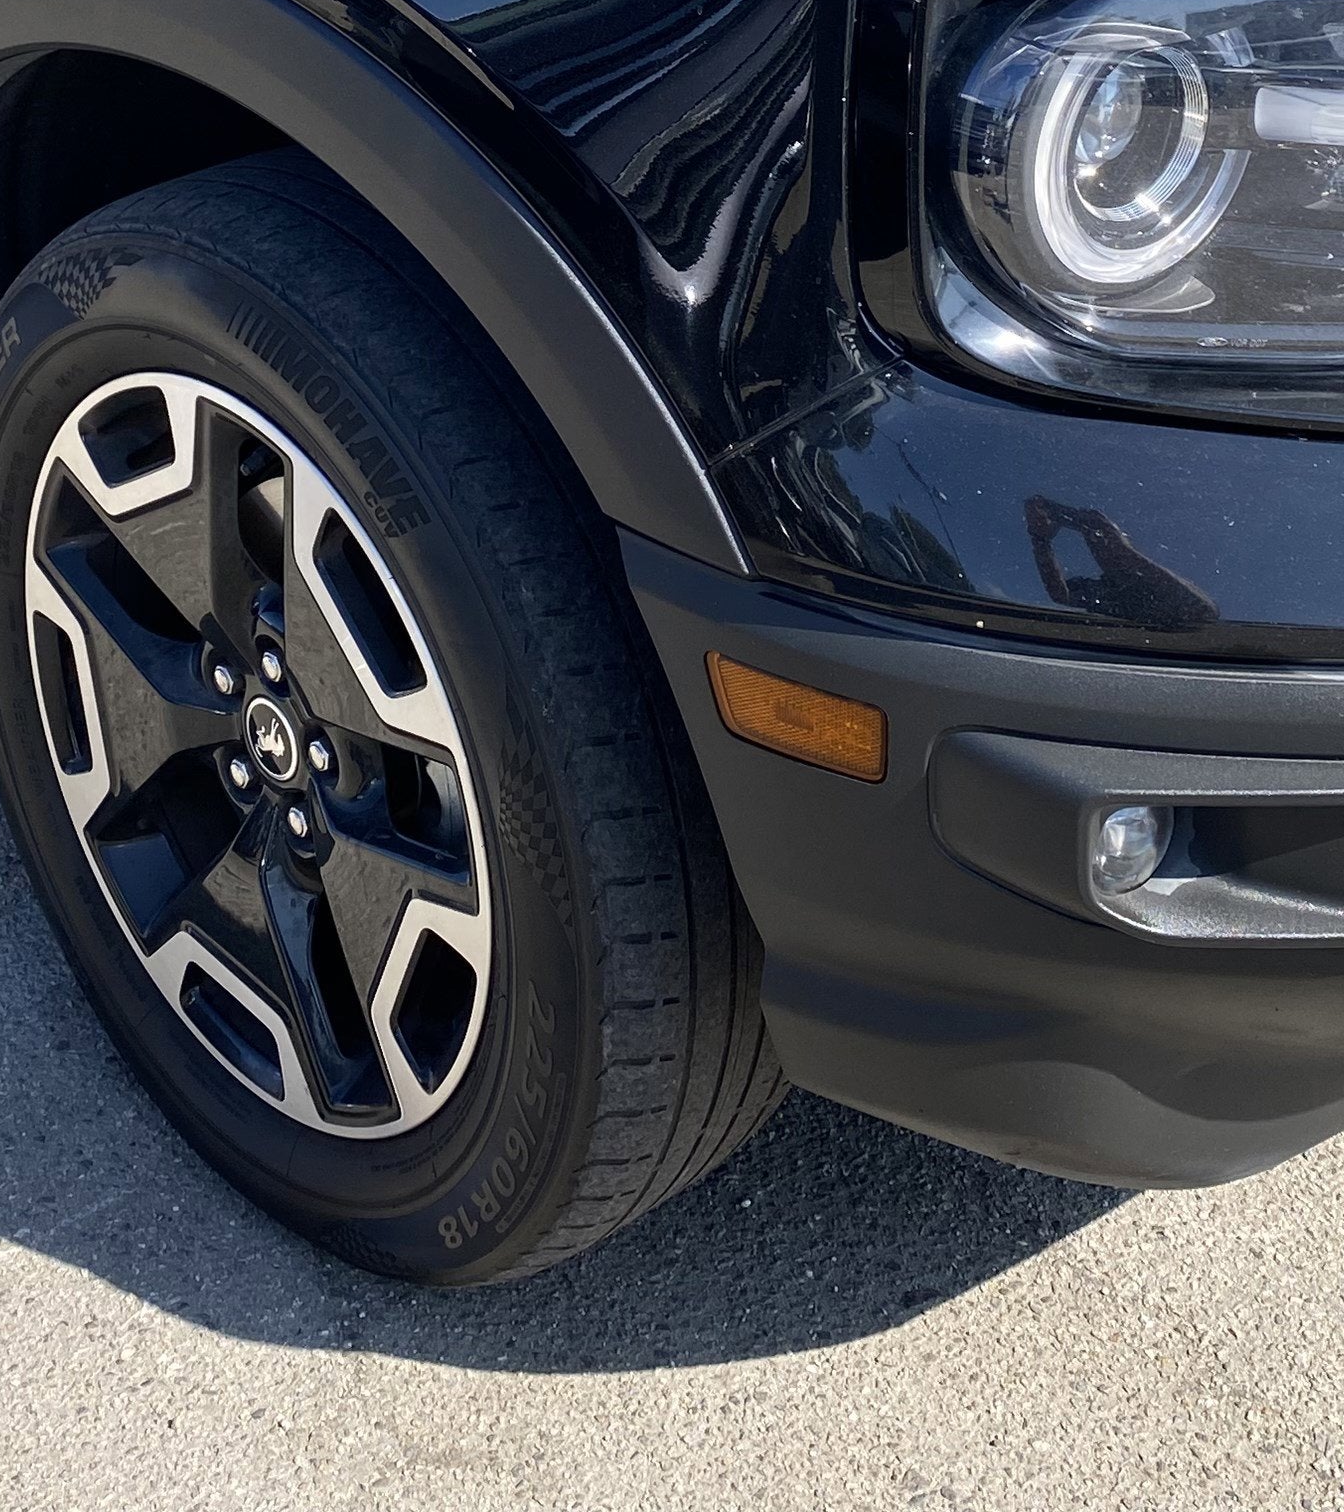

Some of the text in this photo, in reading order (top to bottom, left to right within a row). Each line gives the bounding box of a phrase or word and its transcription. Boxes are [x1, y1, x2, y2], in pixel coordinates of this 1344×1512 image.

[270, 336, 432, 537] MOHAVE
[363, 491, 400, 538] CUV
[437, 979, 555, 1250] 225/60R18
